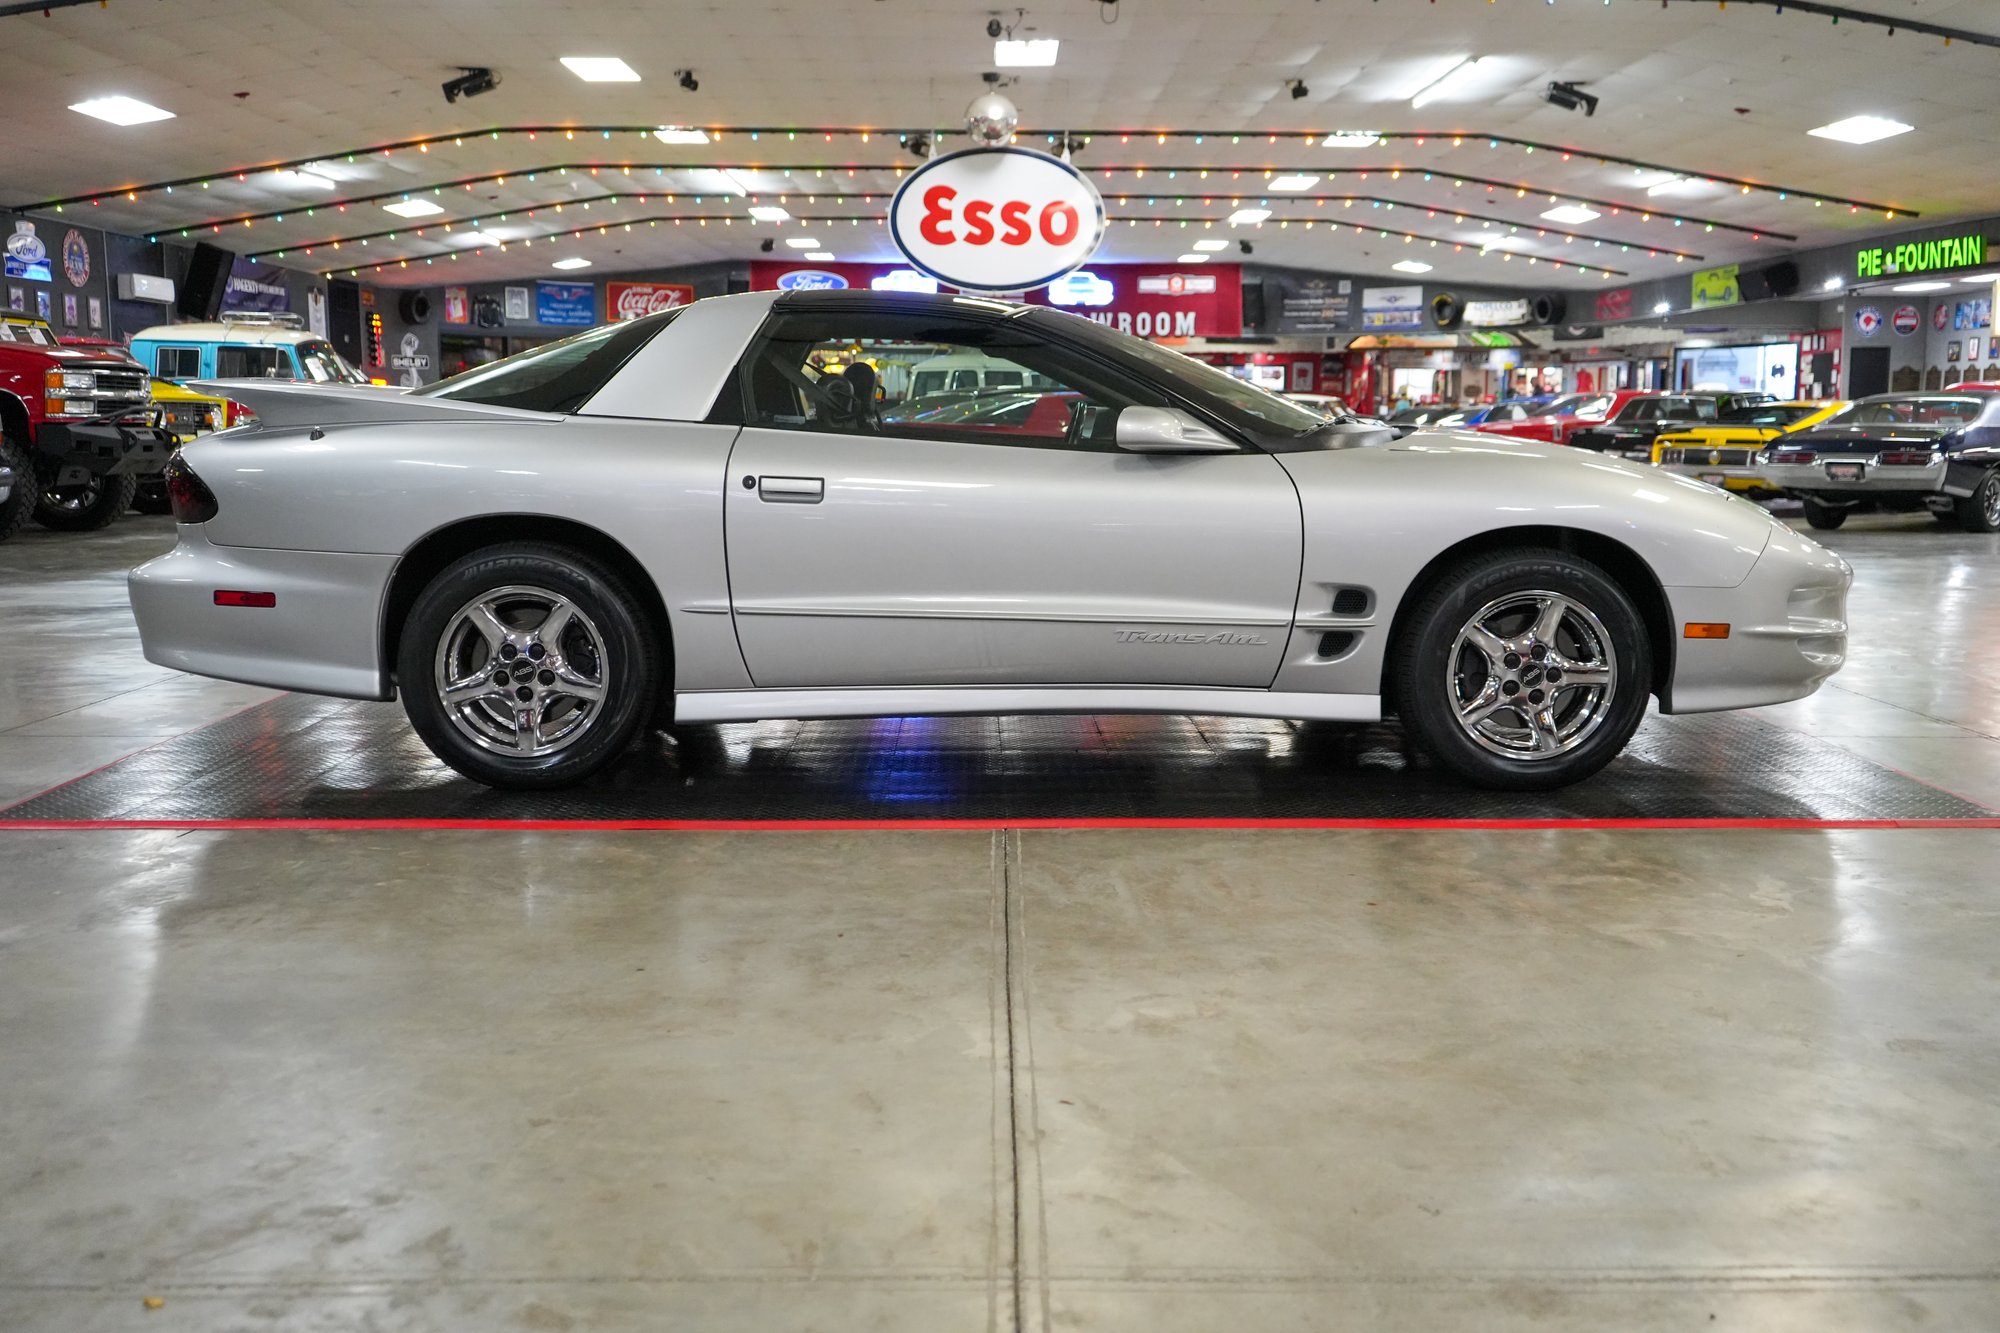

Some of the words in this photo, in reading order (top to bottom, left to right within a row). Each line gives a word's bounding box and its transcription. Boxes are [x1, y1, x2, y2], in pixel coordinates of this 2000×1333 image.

[1858, 248, 1882, 277] PIE
[1895, 235, 1981, 273] FOUNTAIN
[792, 273, 832, 289] Ford
[1074, 311, 1197, 337] WROOM
[393, 357, 427, 367] SHELBY
